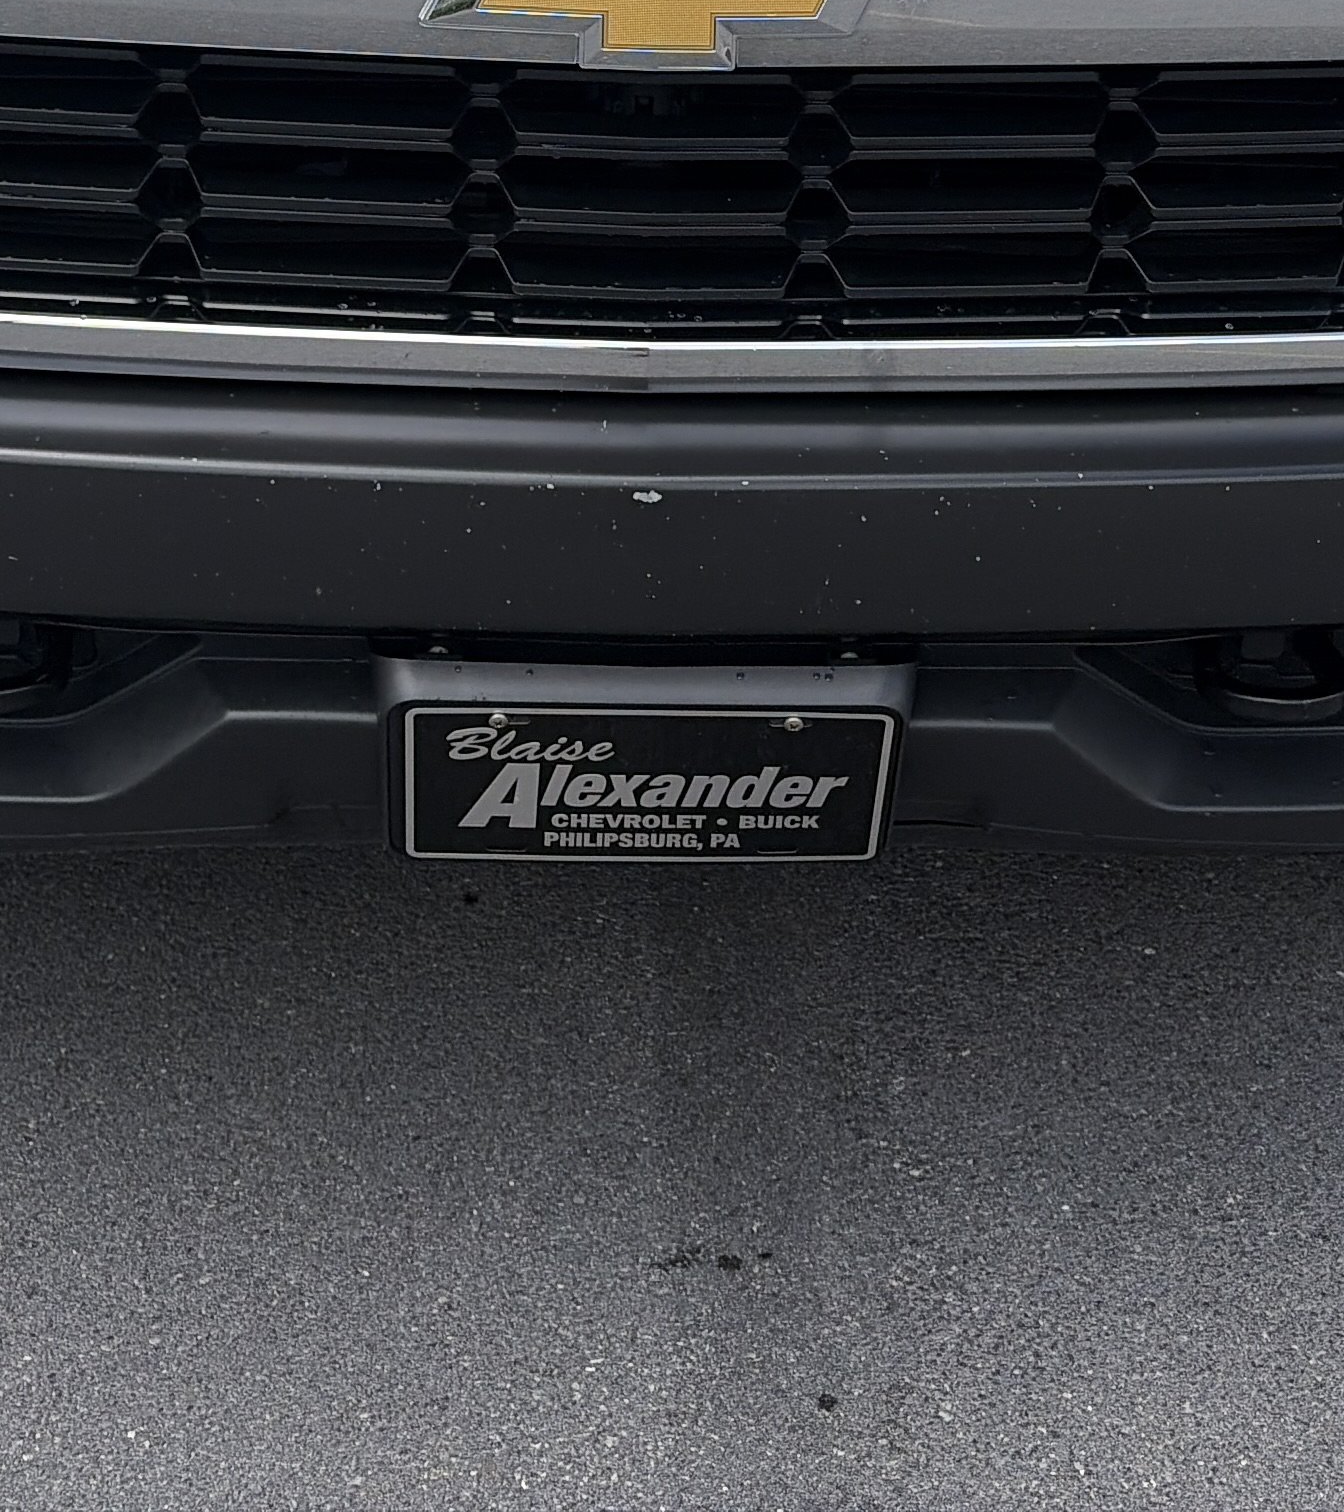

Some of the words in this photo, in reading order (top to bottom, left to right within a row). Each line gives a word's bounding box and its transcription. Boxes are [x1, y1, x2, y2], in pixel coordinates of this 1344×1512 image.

[446, 727, 615, 761] Blaise
[458, 762, 850, 828] Alexander
[551, 813, 707, 829] CHEVROLET
[739, 815, 820, 830] BUICK
[543, 832, 703, 851] PHILIPSBURG,
[710, 834, 741, 849] PA
